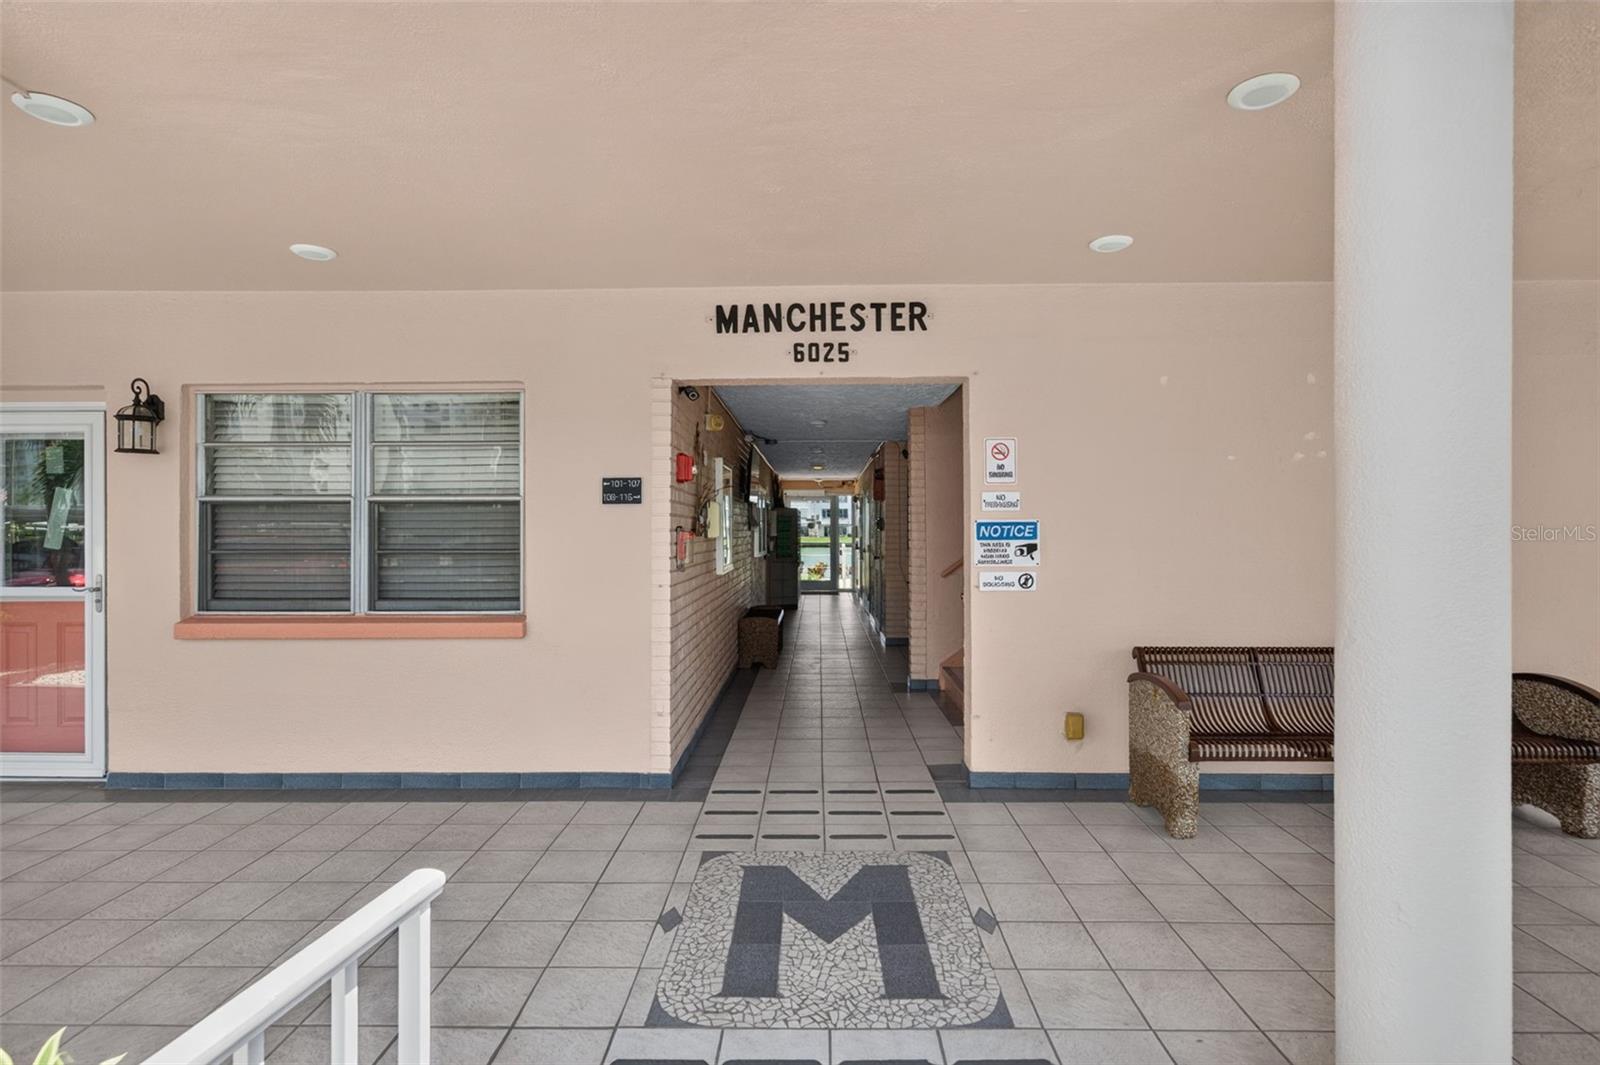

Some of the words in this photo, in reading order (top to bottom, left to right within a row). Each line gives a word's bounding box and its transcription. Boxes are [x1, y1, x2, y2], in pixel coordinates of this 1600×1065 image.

[715, 302, 928, 334] MANCHESTER
[793, 342, 850, 363] 6025
[979, 525, 1035, 538] NOTICE
[713, 865, 951, 1000] M
